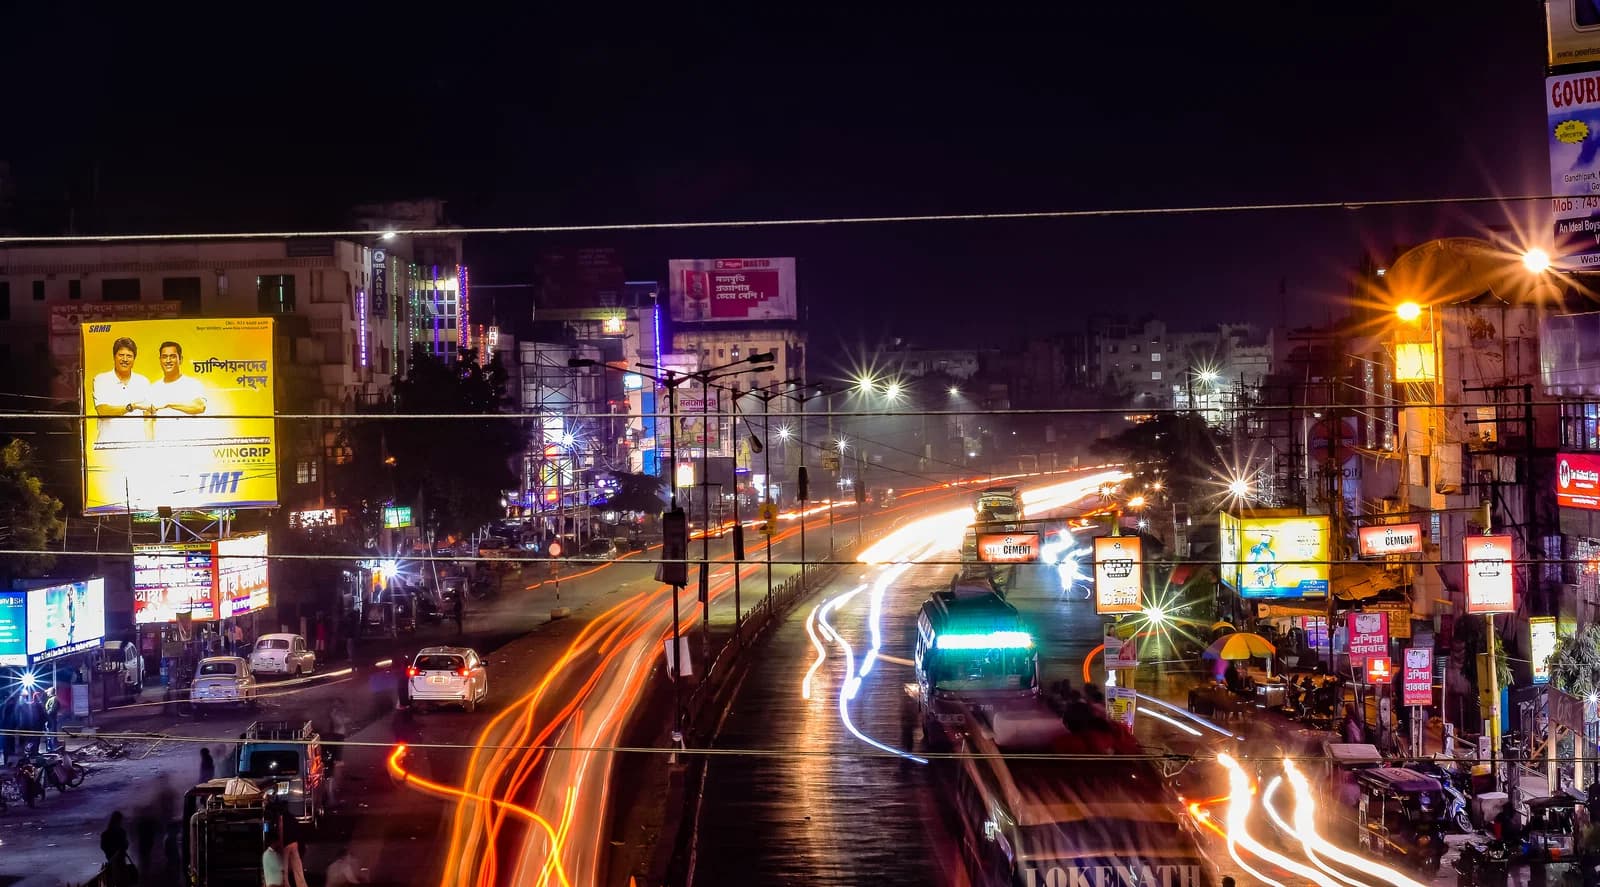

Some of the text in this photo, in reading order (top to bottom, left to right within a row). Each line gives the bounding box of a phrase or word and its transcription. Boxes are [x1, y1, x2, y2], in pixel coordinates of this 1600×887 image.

[1553, 196, 1572, 212] Mob
[1568, 220, 1583, 232] Ideal
[375, 268, 384, 309] PARBAT
[192, 357, 268, 374] চ্যাম্পিয়নদের
[213, 447, 271, 459] WINGRIP
[199, 471, 243, 494] TMT
[1384, 535, 1413, 546] CEMENT
[1002, 545, 1032, 555] CEMENT
[1351, 633, 1384, 645] এশিয়া
[1406, 669, 1430, 681] এশিয়া
[1024, 865, 1201, 887] LOKENATH
